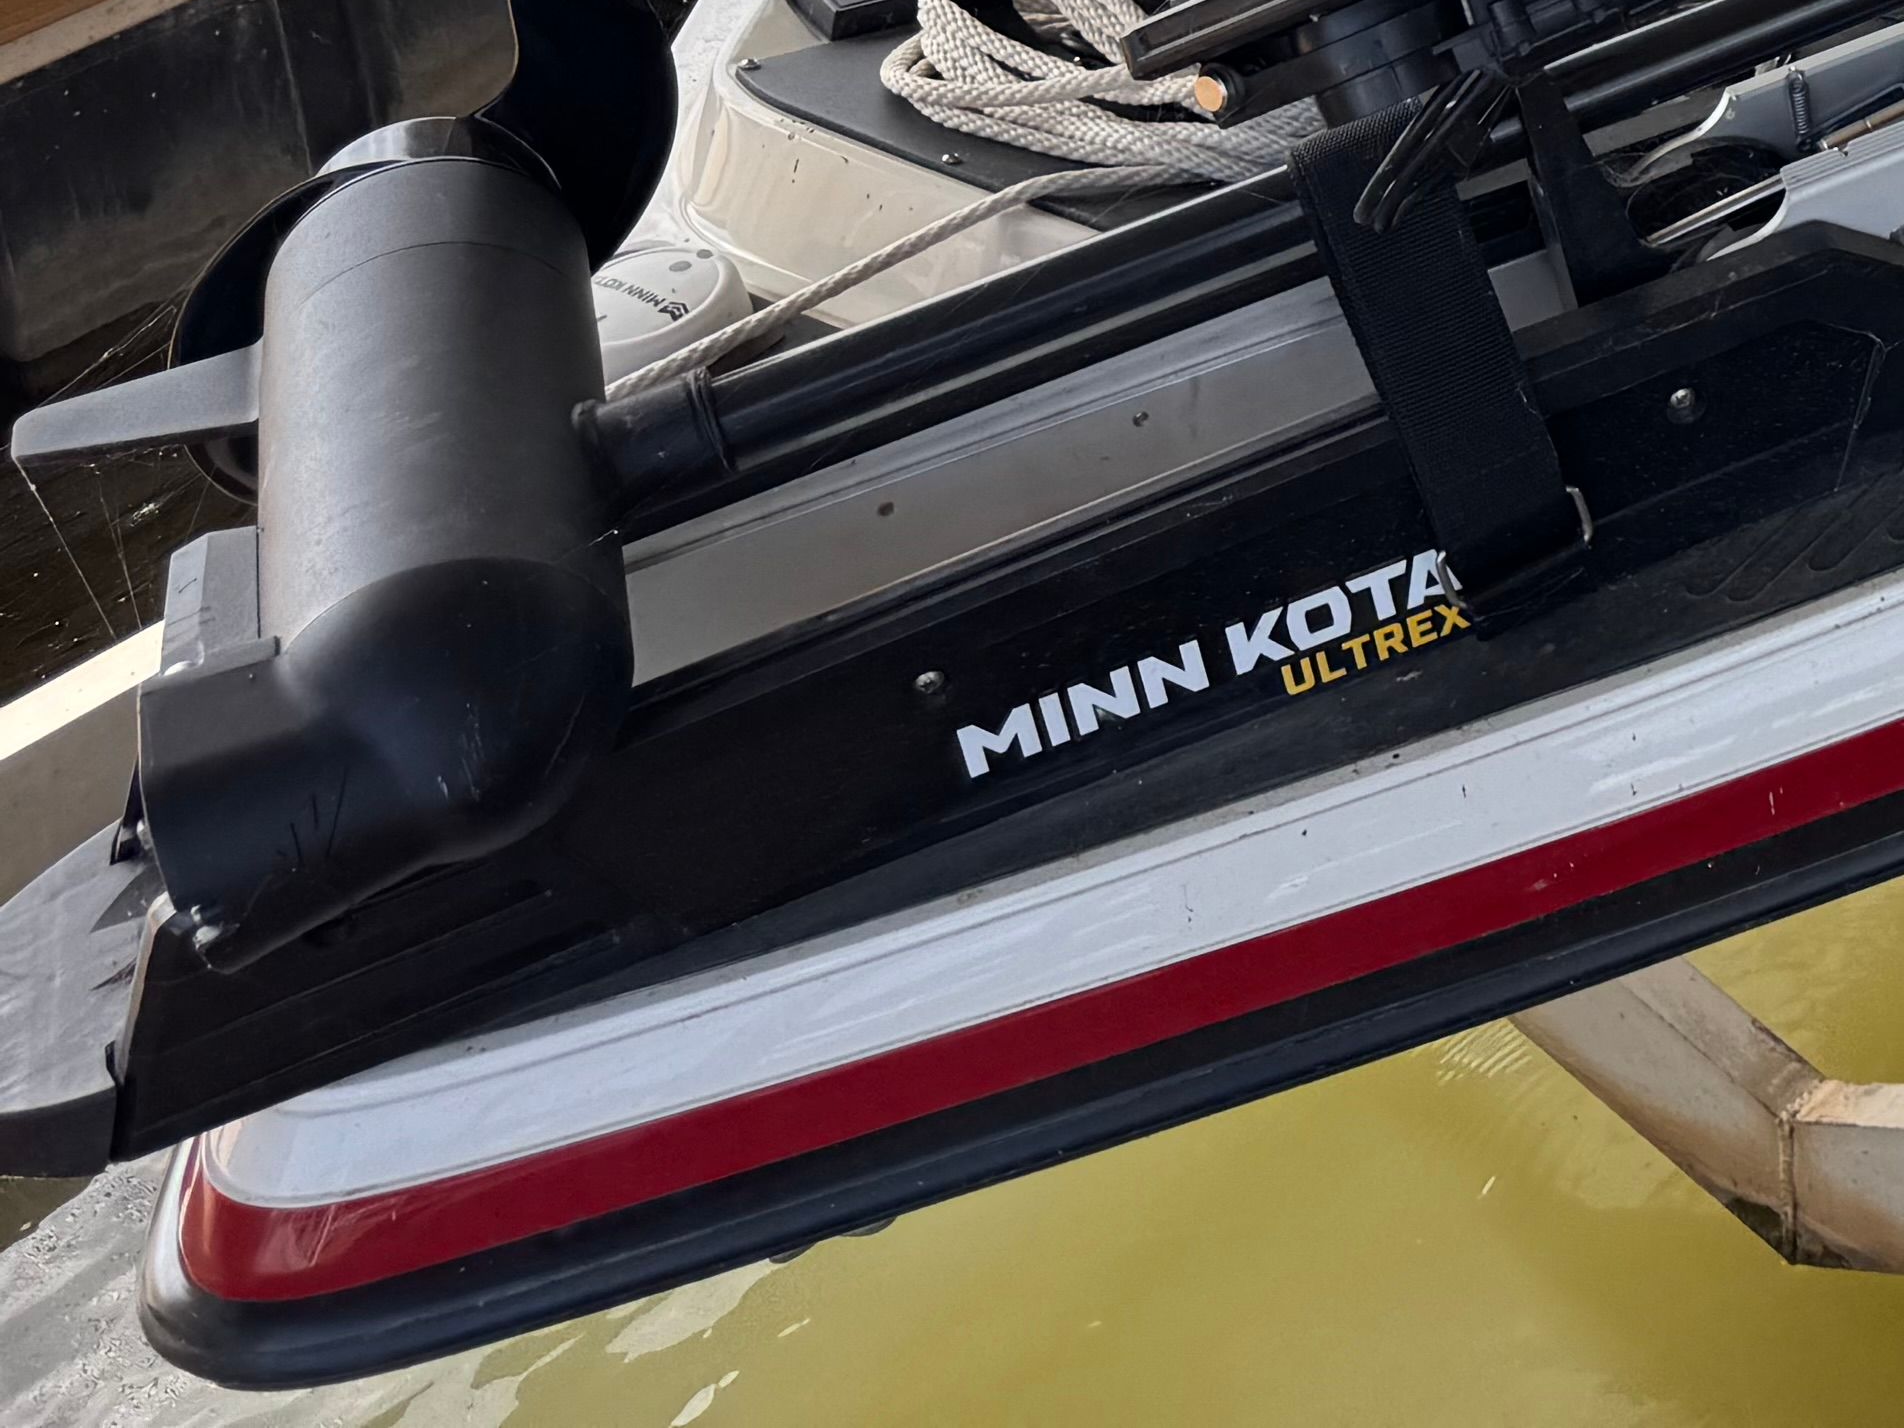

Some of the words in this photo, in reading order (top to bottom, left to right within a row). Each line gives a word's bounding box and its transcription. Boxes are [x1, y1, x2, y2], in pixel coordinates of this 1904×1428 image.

[621, 284, 667, 307] MINN
[956, 639, 1210, 779] MINN
[1224, 548, 1464, 676] KOTA
[1280, 603, 1473, 695] ULTREX
